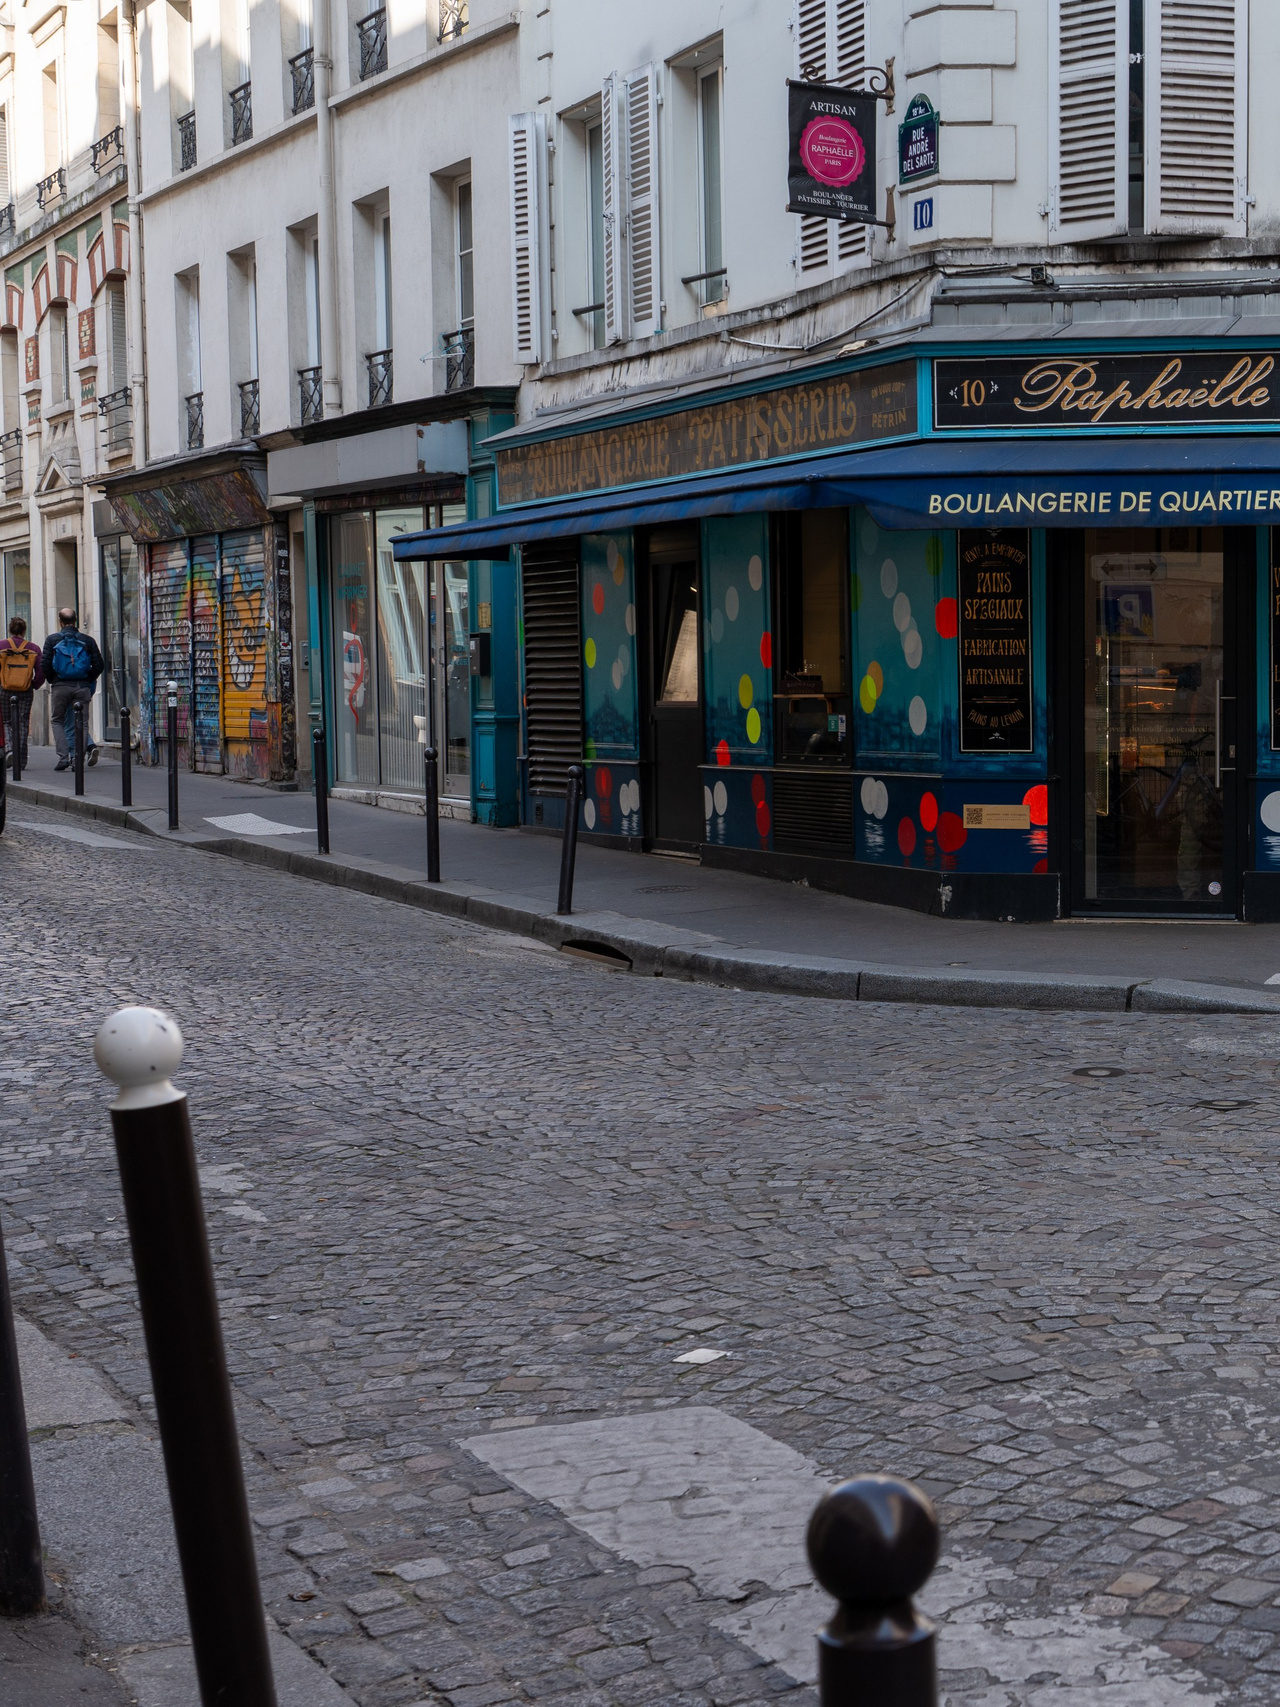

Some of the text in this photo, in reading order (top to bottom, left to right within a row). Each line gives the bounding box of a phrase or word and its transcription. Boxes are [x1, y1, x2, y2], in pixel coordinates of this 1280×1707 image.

[809, 101, 856, 117] ARTISAN
[818, 134, 847, 144] Boulangerie
[912, 127, 925, 142] RUE
[811, 144, 854, 158] RAPHAËLLE
[908, 137, 929, 157] ANDRÉ
[824, 158, 842, 167] PARIS
[903, 153, 935, 172] DEL SARTE
[797, 194, 832, 206] PÂTISSIER
[836, 200, 869, 212] TOURRIER
[812, 190, 854, 202] BOULANGER
[916, 203, 930, 228] 10
[960, 378, 986, 407] 10
[1013, 354, 1276, 423] Raphaëlle
[527, 423, 670, 493] BOULANGERIE
[928, 491, 1111, 515] BOULANGERIE
[1119, 491, 1151, 512] DE
[963, 543, 984, 564] VENTE
[991, 542, 1027, 565] EMPORTER
[976, 572, 1012, 593] PAINS
[964, 598, 1024, 620] SPECIAUX
[964, 638, 1026, 656] FABRICATION
[966, 668, 1024, 685] ARTISANALE
[966, 708, 1025, 728] PAINS AU LEVAIN
